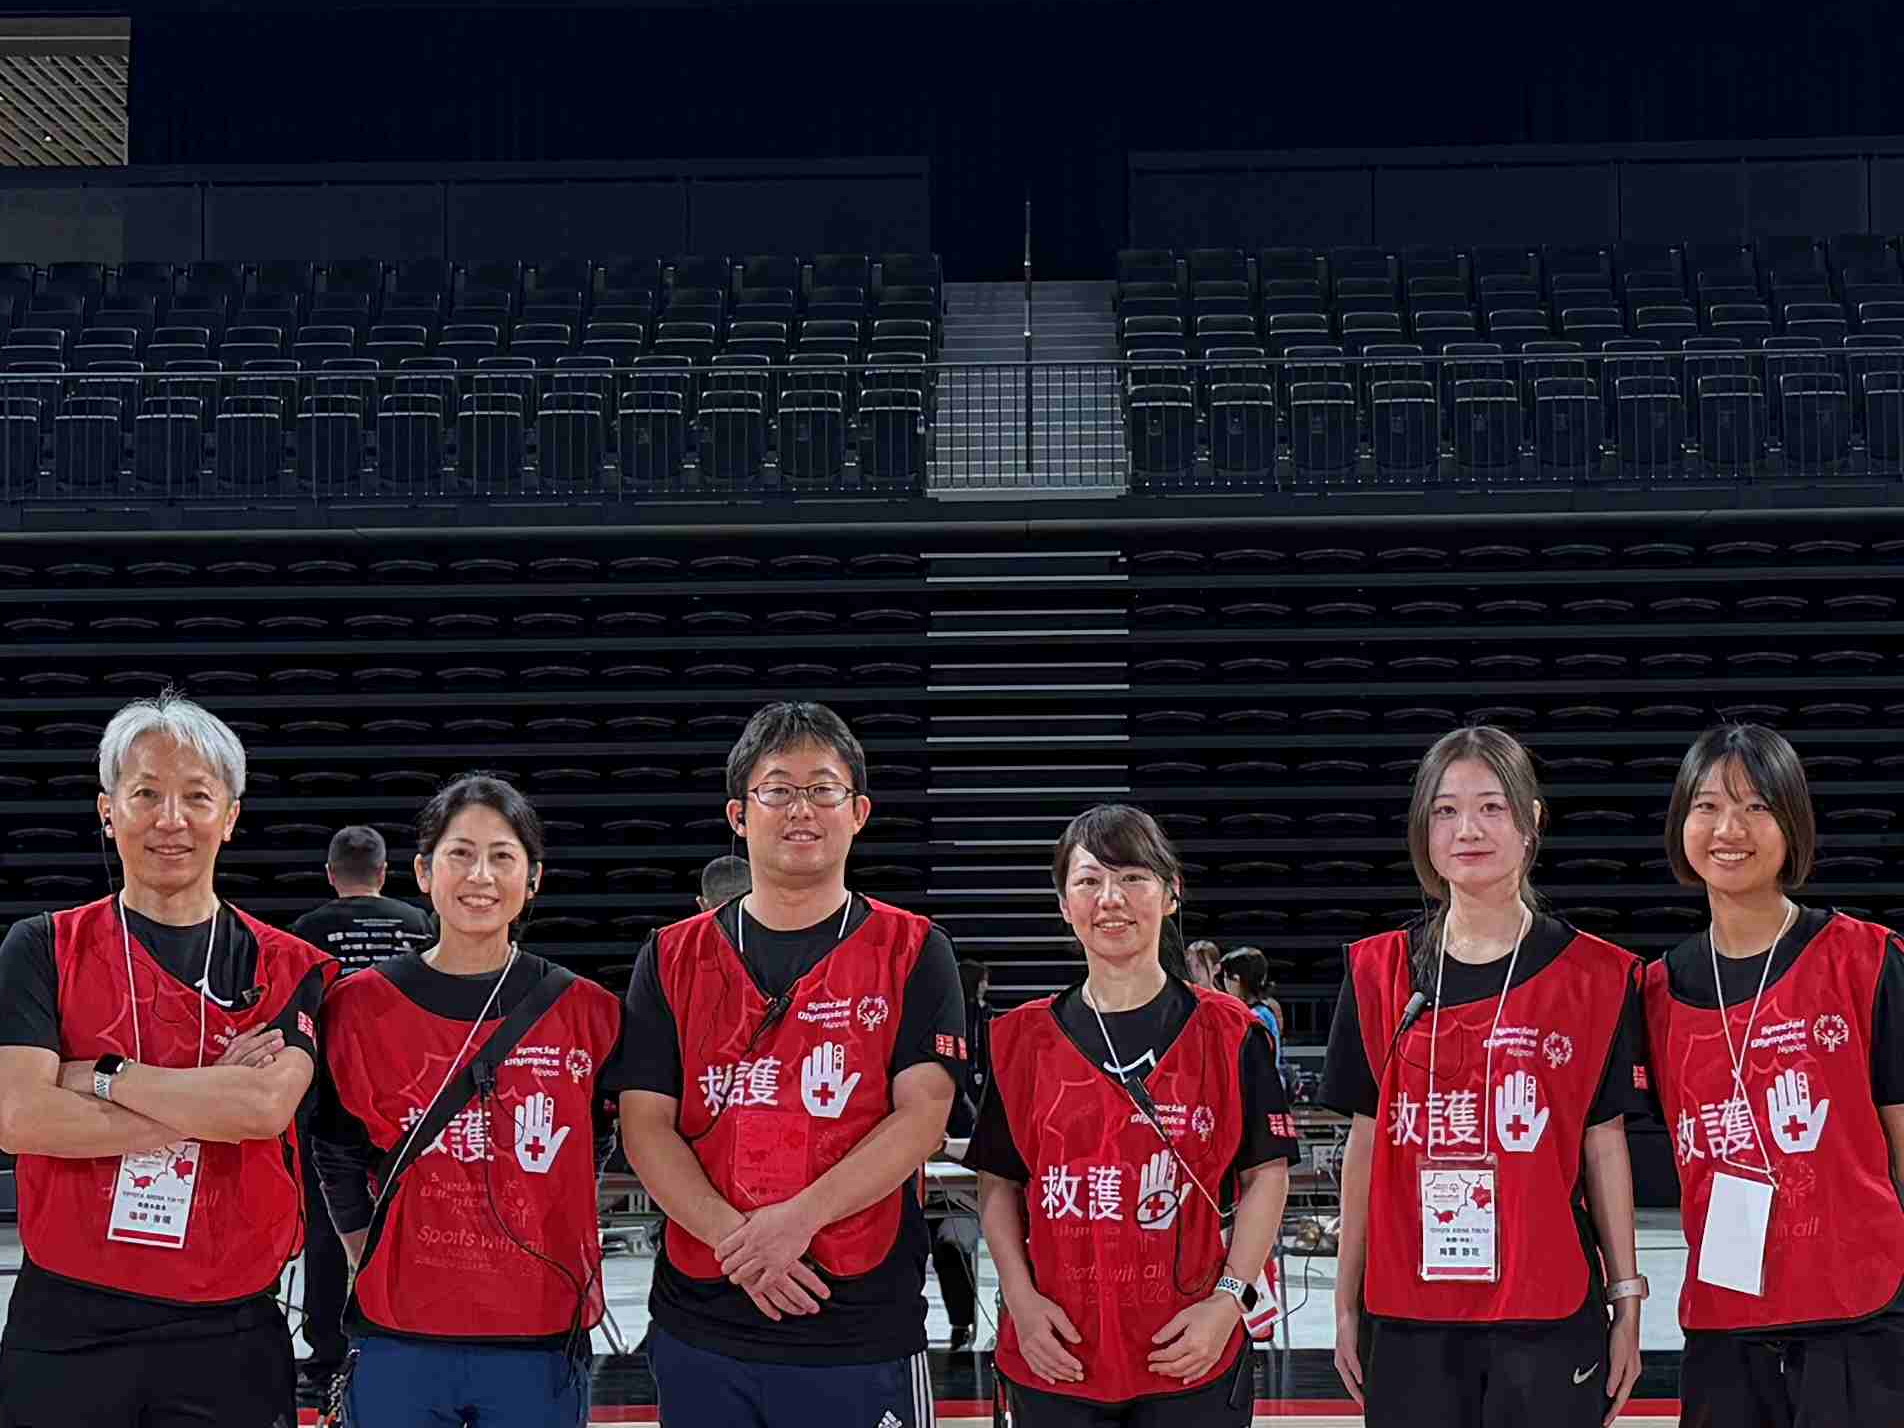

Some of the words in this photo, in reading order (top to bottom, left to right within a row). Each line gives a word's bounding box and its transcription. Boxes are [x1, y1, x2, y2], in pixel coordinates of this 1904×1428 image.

[1387, 1089, 1481, 1147] 救護
[1677, 1098, 1754, 1166] 救護
[1040, 1164, 1125, 1221] 救護
